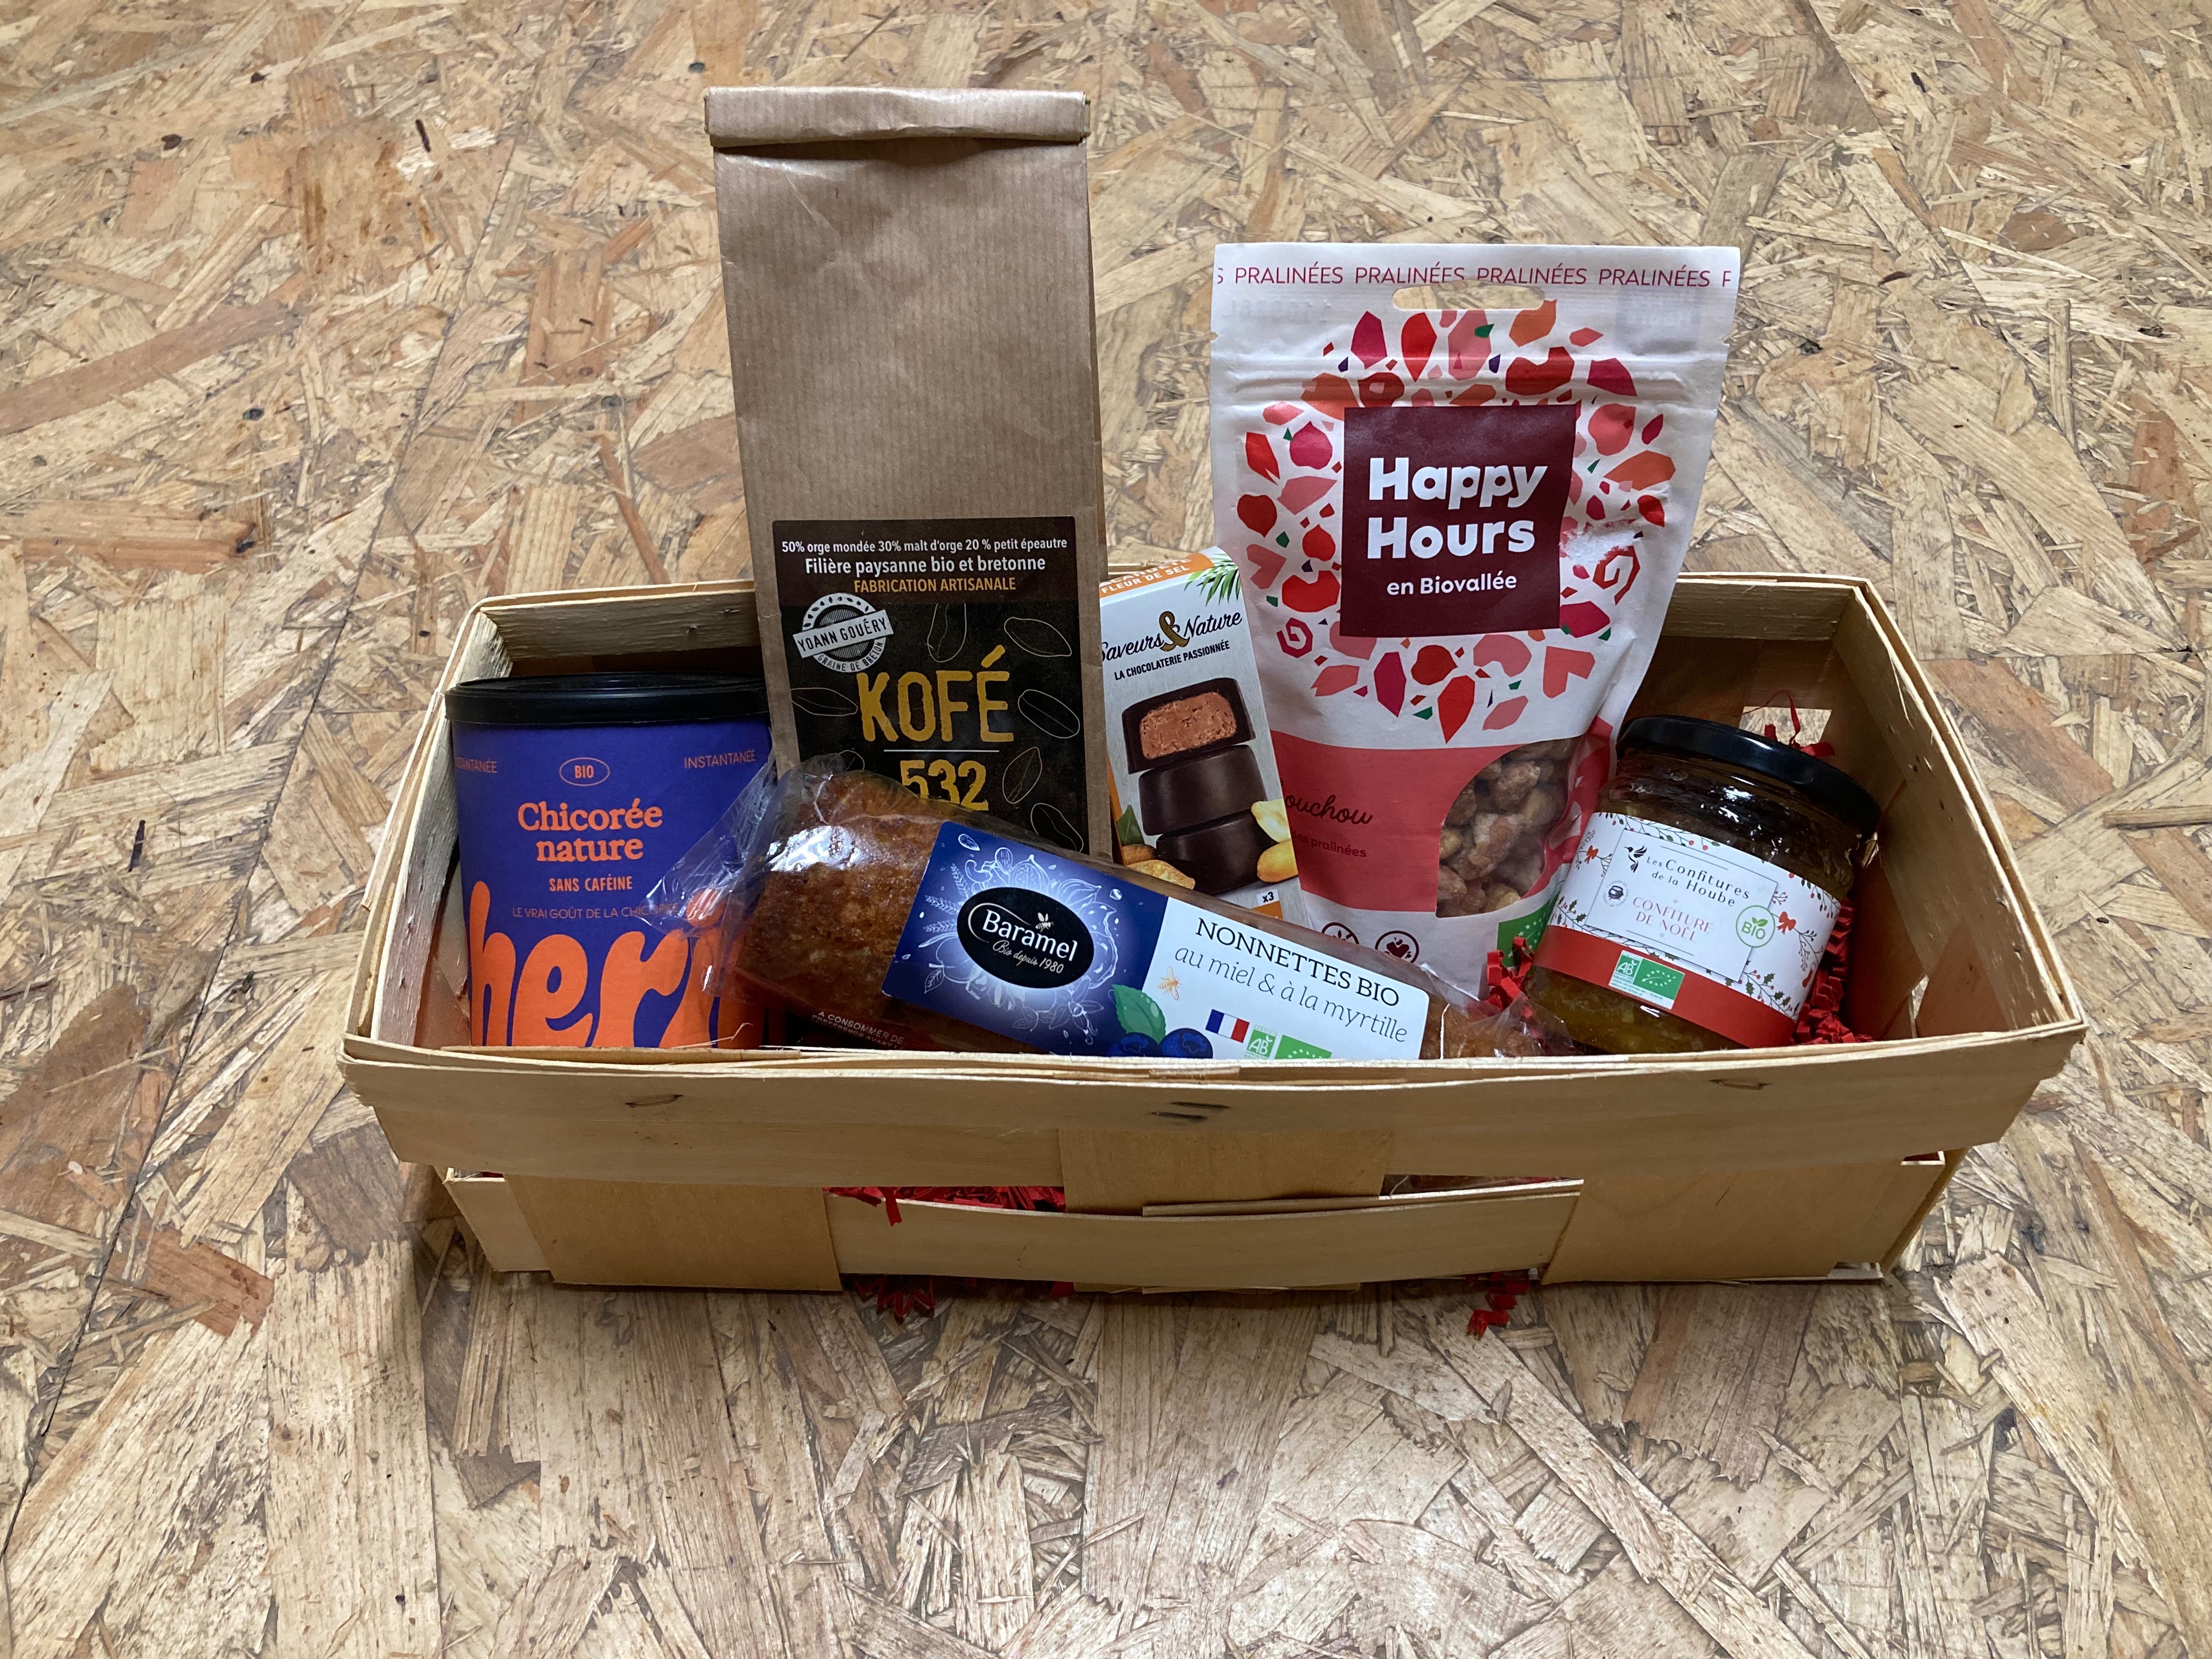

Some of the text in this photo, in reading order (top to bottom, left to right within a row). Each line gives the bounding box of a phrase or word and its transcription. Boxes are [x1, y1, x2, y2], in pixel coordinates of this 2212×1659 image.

[1235, 261, 1343, 284] PRALINÉES
[1355, 261, 1464, 284] PRALINÉES
[1477, 263, 1587, 284] PRALINÉES
[1599, 264, 1710, 287] PRALINÉES
[1370, 457, 1547, 510] Happy
[782, 541, 805, 552] 50%
[808, 543, 830, 555] orge
[833, 540, 876, 552] mondée
[879, 540, 901, 552] 30%
[904, 540, 928, 552] malt
[966, 539, 979, 550] 20
[982, 539, 991, 550] %
[994, 538, 1019, 552] petit
[1021, 538, 1068, 552] épeautre
[1367, 517, 1535, 560] Hours
[805, 555, 1046, 578] Filière paysanne bio et bretonne
[1101, 565, 1190, 594] FLEUR DE SEL
[854, 577, 1016, 593] FABRICATION ARTISANALE
[1387, 572, 1517, 596] en Biovallée
[798, 617, 887, 651] YOANN GOUÉRY
[1102, 633, 1164, 662] Saveurs
[1183, 612, 1243, 638] Nature
[818, 642, 883, 671] GRAINE DE BRETON
[1114, 639, 1230, 681] LA CHOCOLATERIE PASSIONNÉE
[856, 644, 1014, 742] KOFÉ
[574, 765, 594, 778] BIO
[684, 748, 755, 770] INSTANTANÉE
[900, 759, 989, 811] 532
[518, 798, 663, 832] Chicorée
[1283, 793, 1373, 825] ouchou
[536, 837, 644, 862] nature
[1311, 838, 1367, 857] pralinées
[549, 874, 633, 891] SANS CAFÉINE
[1646, 856, 1750, 900] Les Confitures
[1651, 871, 1735, 907] de la Hoube
[512, 907, 522, 918] LE
[524, 908, 548, 918] VRAI
[549, 906, 582, 919] GOÛT
[586, 909, 601, 919] DE
[603, 907, 619, 918] LA
[1262, 891, 1274, 903] x3
[1633, 896, 1712, 933] CONFITURE
[1635, 911, 1696, 943] DE NOËL
[1741, 921, 1766, 940] BIO
[983, 909, 1078, 961] Baramel
[992, 940, 1064, 974] Bio depuis 1980
[1195, 917, 1399, 1007] NONNETTES BIO
[1175, 947, 1408, 1042] au miel & à la myrtille
[828, 1014, 889, 1040] CONSOMMER
[890, 1035, 904, 1045] DE
